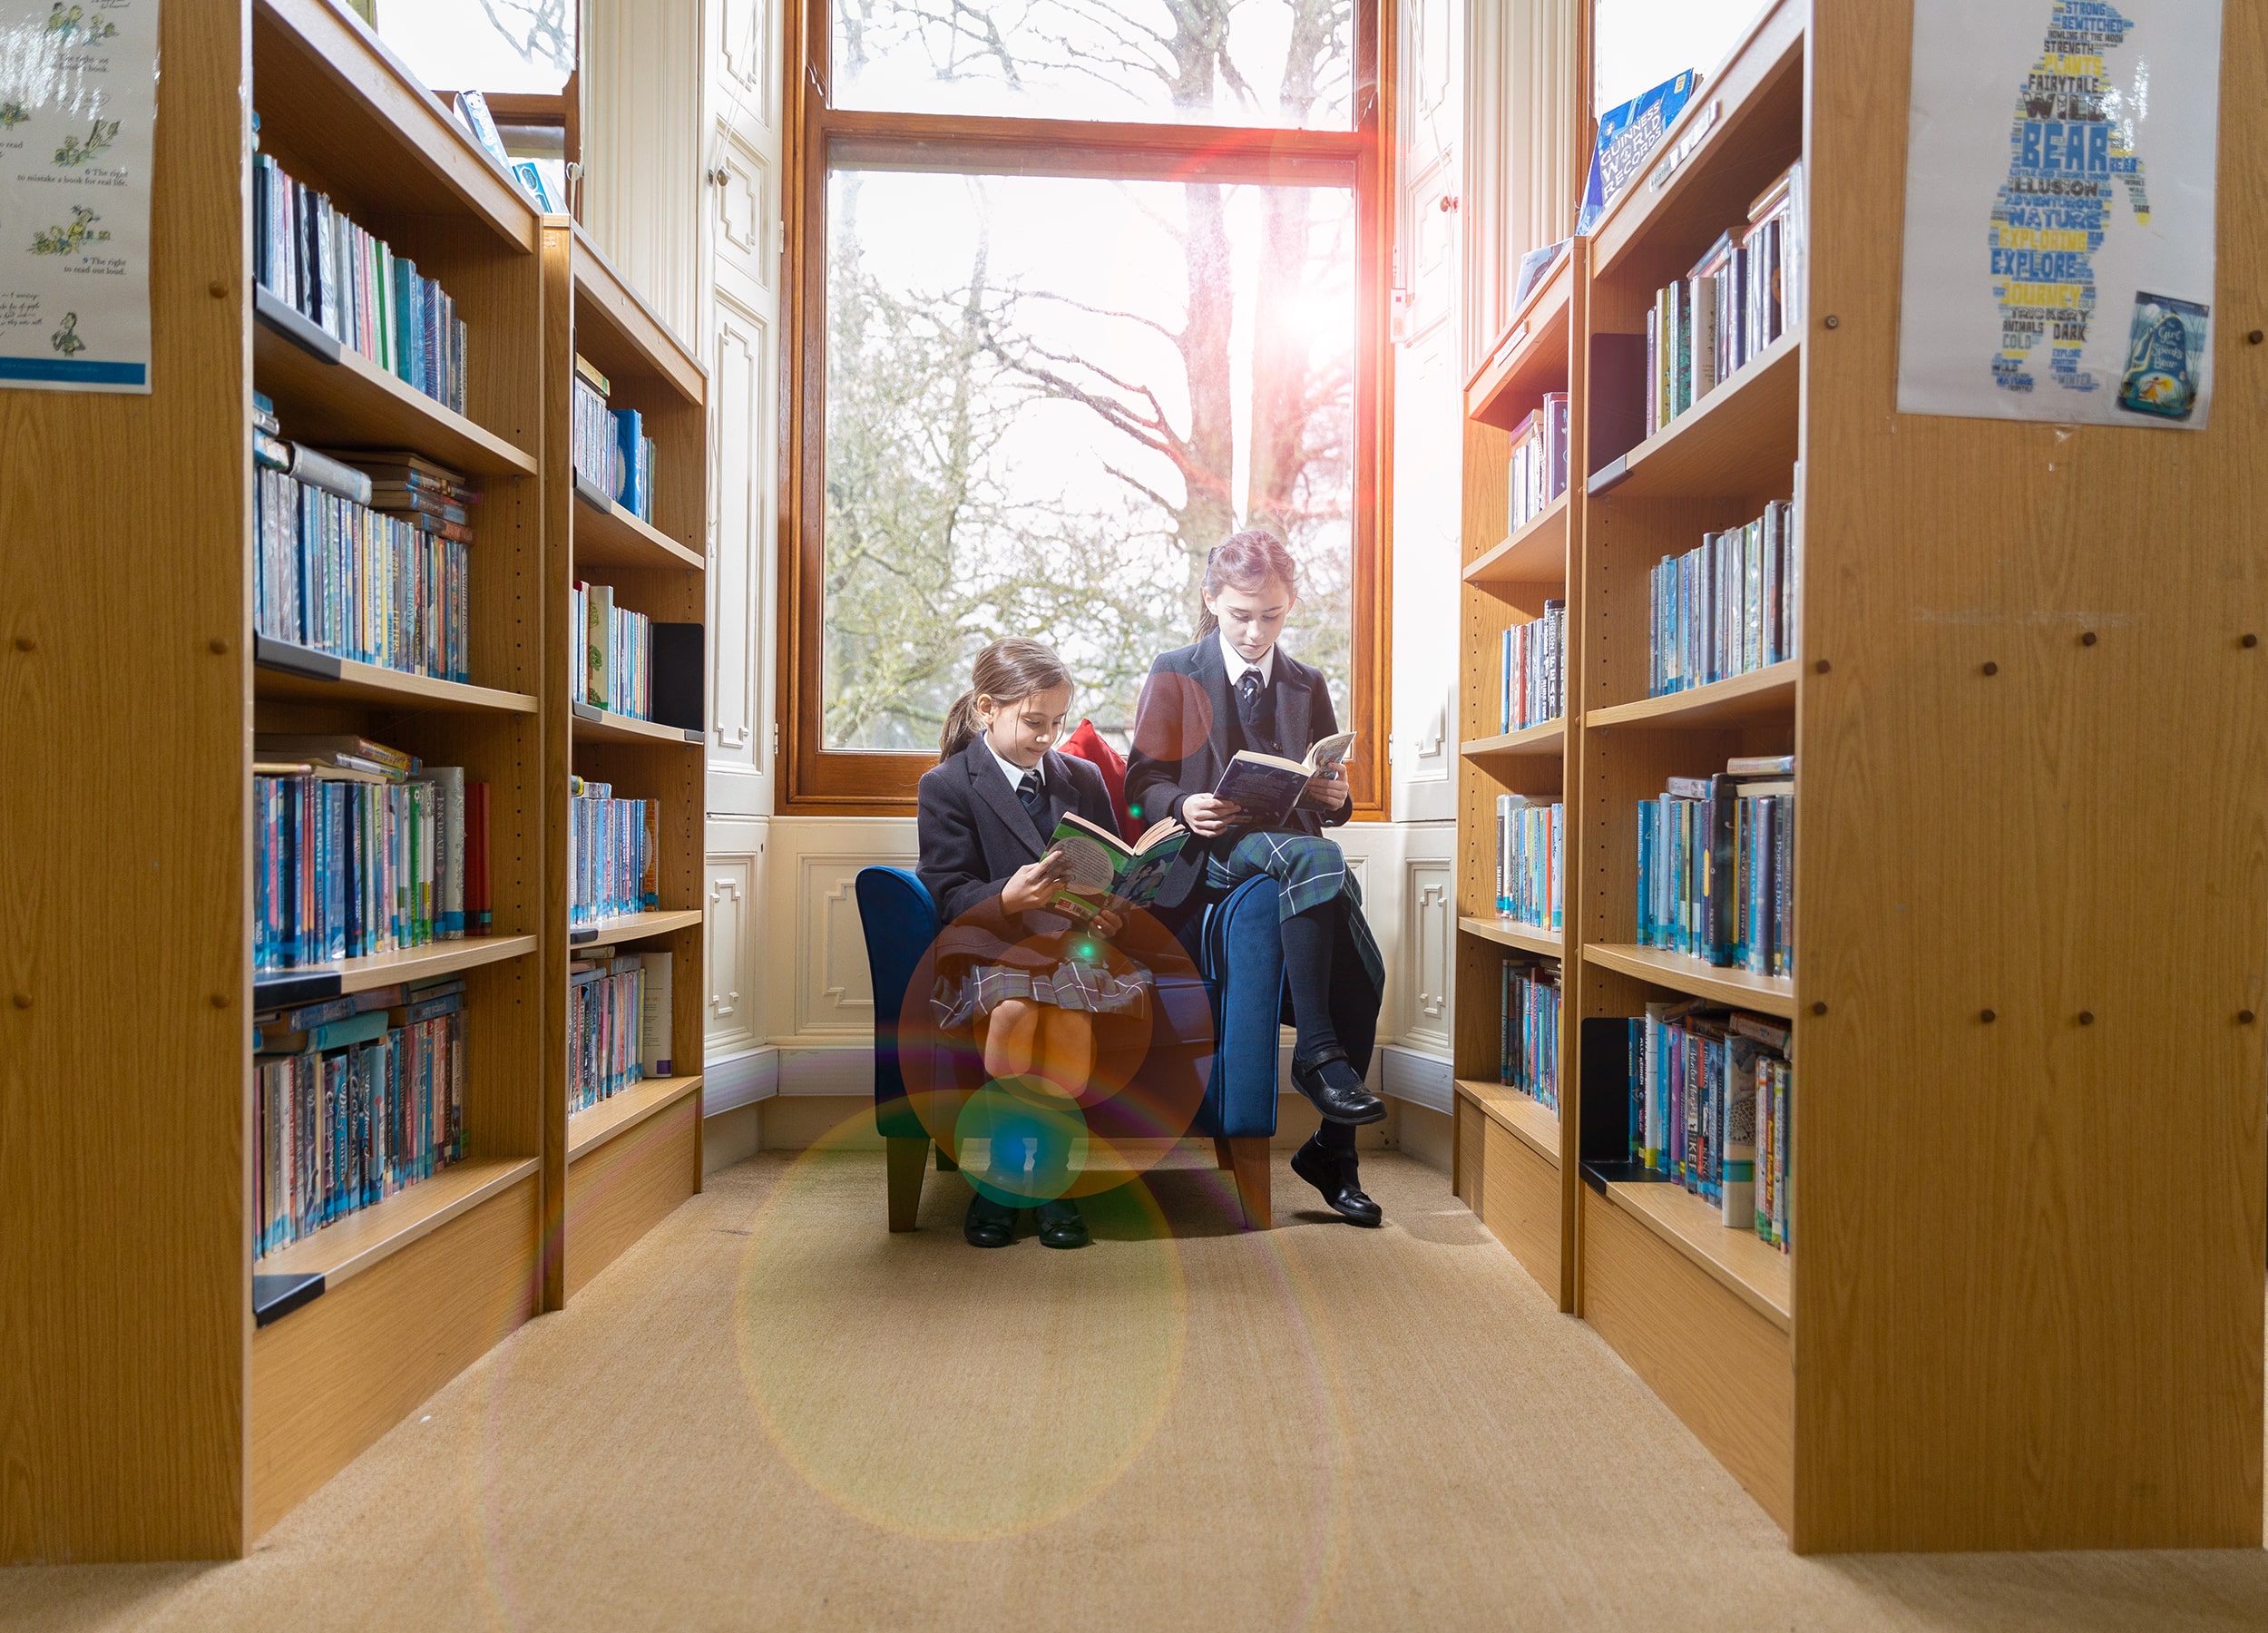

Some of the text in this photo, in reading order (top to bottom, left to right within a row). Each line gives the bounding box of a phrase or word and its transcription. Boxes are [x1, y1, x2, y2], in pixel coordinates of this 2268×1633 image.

[2066, 3, 2107, 15] STRONG
[2061, 16, 2123, 32] BEWITCHED
[2048, 30, 2124, 44] HOWLING AT THE MOON
[2044, 41, 2094, 55] STRENGTH
[2044, 54, 2103, 76] PLANTS
[2028, 73, 2099, 93] FAIRYTALE
[2021, 92, 2107, 121] WILD
[1601, 102, 1660, 166] GUINNESS
[1602, 114, 1661, 181] WORLD
[2021, 122, 2109, 172] BEAR
[1604, 129, 1662, 199] RECORDS
[2109, 158, 2136, 172] BEAR
[27, 174, 55, 183] mistake
[64, 175, 83, 185] book
[85, 176, 96, 185] for
[98, 177, 112, 186] real
[92, 169, 108, 177] The
[2008, 176, 2098, 197] ILLUSION
[2004, 194, 2104, 210] ADVENTUROUS
[2134, 205, 2150, 213] DARK
[2009, 208, 2102, 230] NATURE
[1999, 228, 2087, 251] EXPLORING
[90, 258, 106, 266] The
[108, 258, 126, 268] right
[1990, 249, 2077, 279] EXPLORE
[106, 267, 127, 276] loud.
[2000, 282, 2083, 308] JOURNEY
[2077, 299, 2096, 309] COLD
[2009, 308, 2090, 321] TRICKERY
[2002, 320, 2044, 334] ANIMALS
[2053, 323, 2087, 342] DARK
[2158, 326, 2181, 340] Girl
[2002, 334, 2032, 349] COLD
[2052, 348, 2082, 358] EXPLORE
[2151, 344, 2184, 358] Speaks
[2154, 357, 2178, 369] Bear
[2058, 373, 2092, 386] WINTER
[333, 801, 343, 860] INKSPELL
[436, 797, 445, 860] INKDEATH
[1689, 1052, 1697, 1117] Winter Horses
